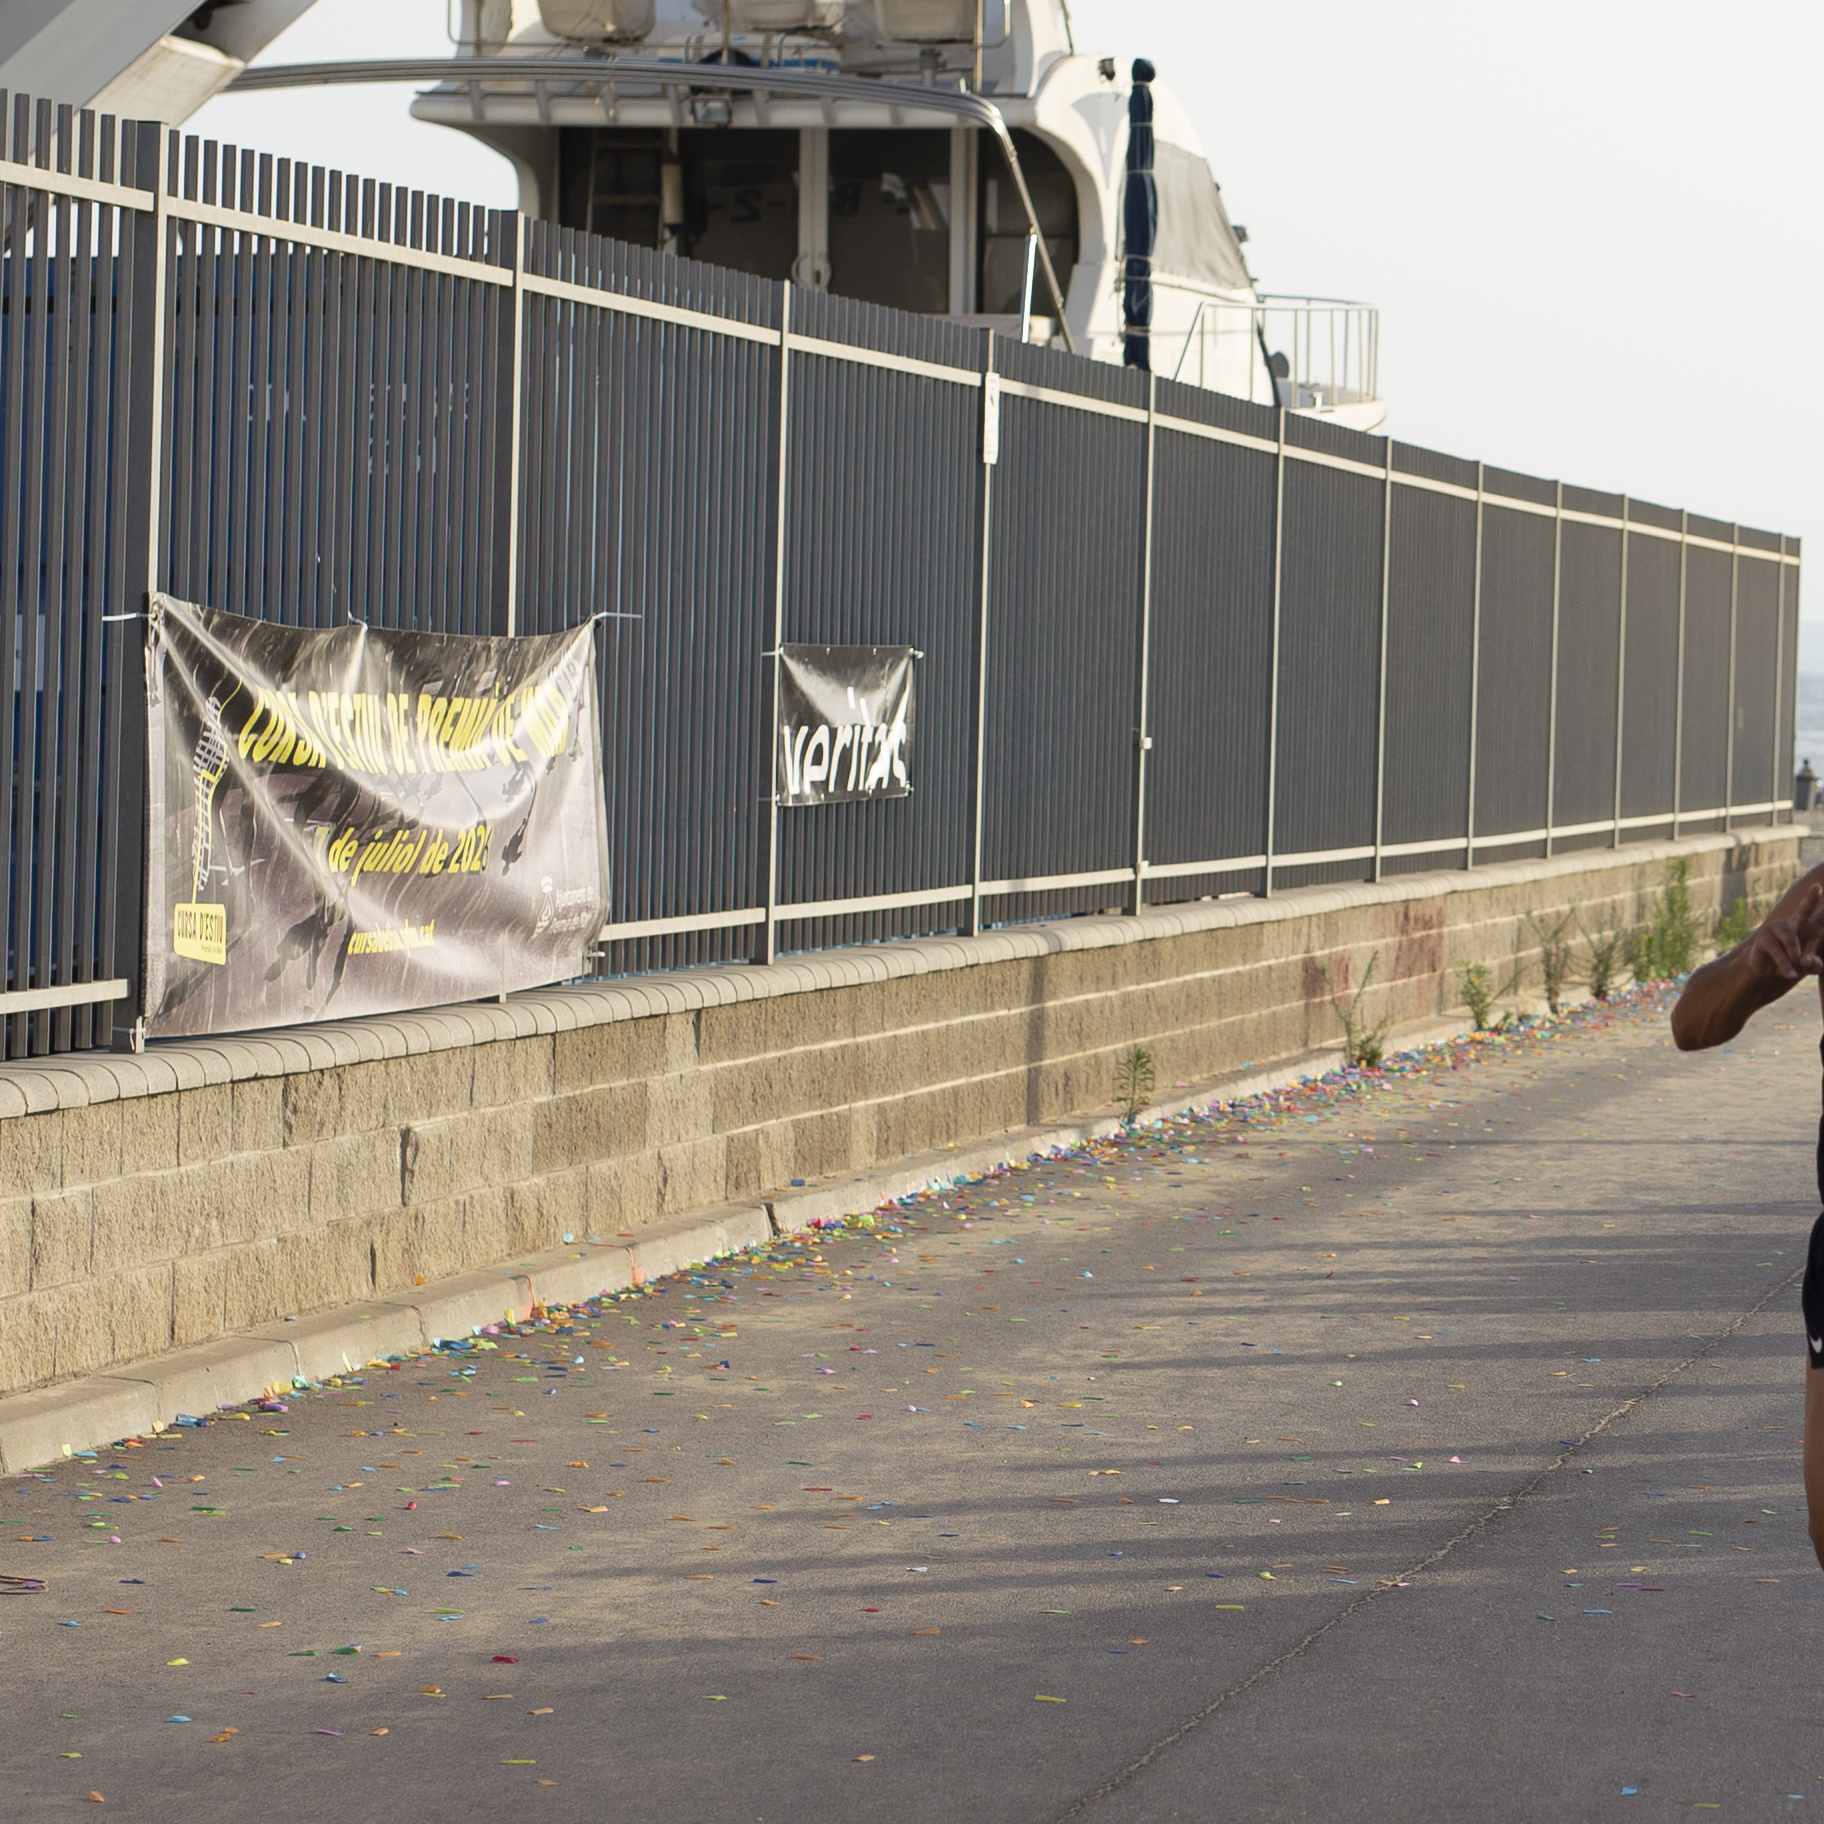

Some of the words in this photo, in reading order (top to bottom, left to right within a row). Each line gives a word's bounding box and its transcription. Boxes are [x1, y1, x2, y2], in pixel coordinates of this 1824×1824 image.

[328, 827, 358, 874] de
[351, 829, 428, 887] juliol
[419, 828, 449, 874] de
[177, 910, 197, 940] CURSA
